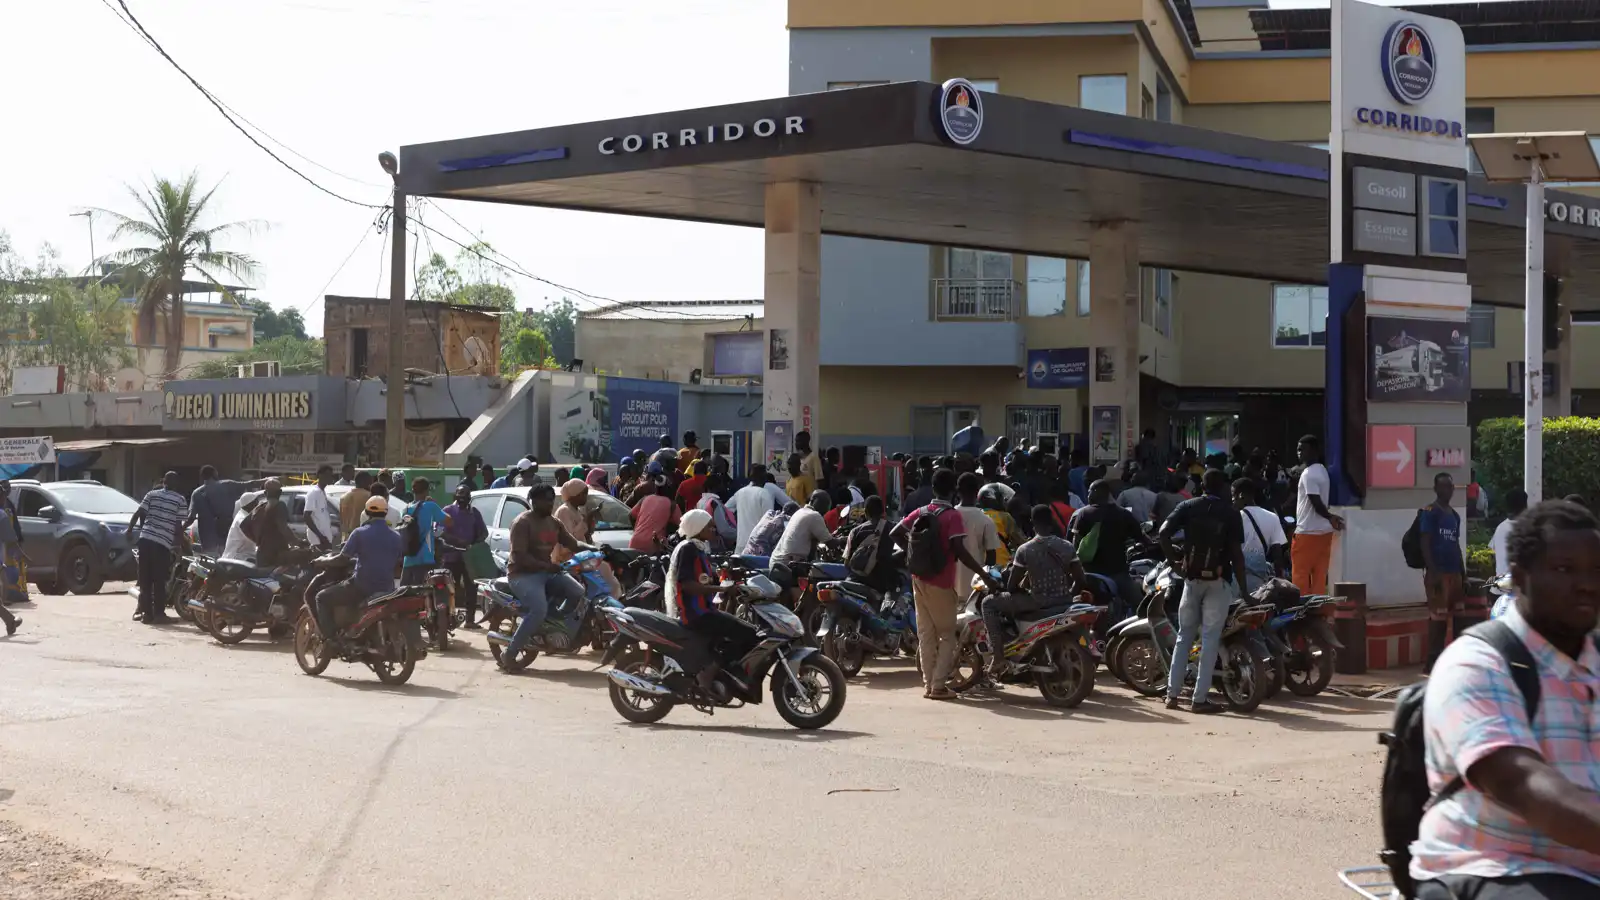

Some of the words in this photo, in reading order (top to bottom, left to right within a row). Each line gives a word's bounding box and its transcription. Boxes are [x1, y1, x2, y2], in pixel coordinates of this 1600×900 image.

[1399, 72, 1428, 83] CORRIDOR
[1357, 107, 1462, 138] CORRIDOR
[598, 116, 804, 155] CORRIDOR
[1368, 182, 1406, 199] Gasoil
[1544, 199, 1600, 228] ORR
[1364, 220, 1408, 236] Essence
[175, 393, 212, 419] DECO
[218, 391, 309, 418] LUMINAIRES
[627, 399, 635, 410] LE
[636, 400, 661, 412] PARFAIT
[621, 412, 649, 424] PRODUIT
[650, 413, 668, 425] POUR
[619, 425, 640, 437] VOTRE
